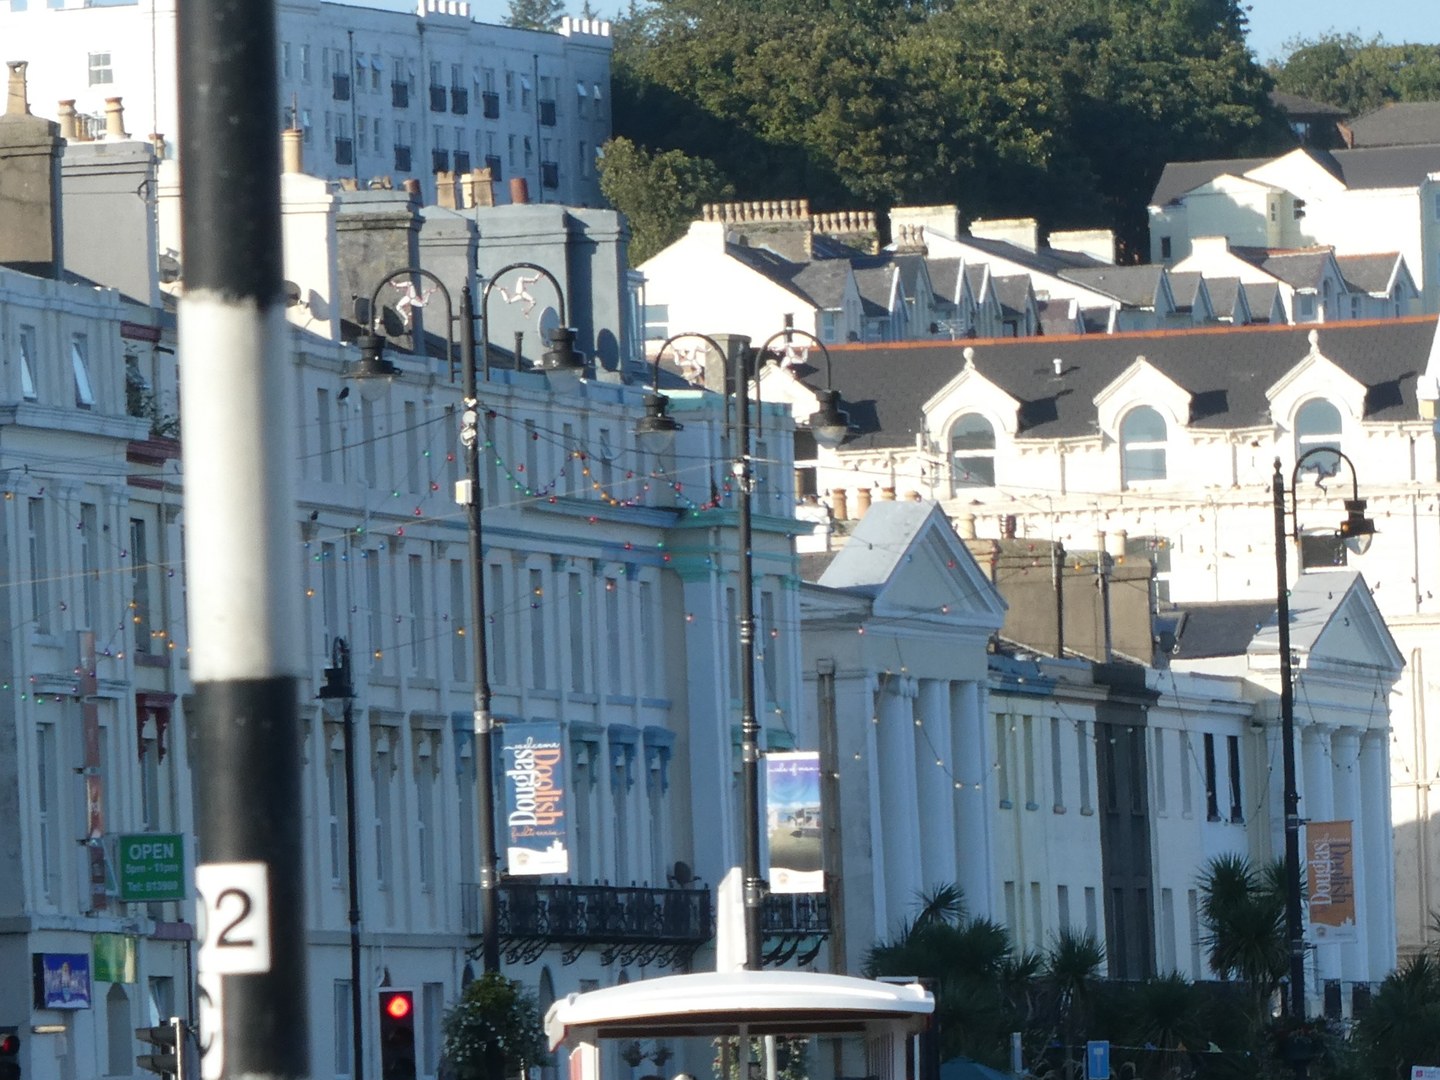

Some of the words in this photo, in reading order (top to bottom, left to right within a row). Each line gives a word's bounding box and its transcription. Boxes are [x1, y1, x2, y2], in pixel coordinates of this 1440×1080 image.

[507, 749, 541, 826] Douglas
[535, 749, 563, 826] Doolish
[129, 843, 175, 860] OPEN
[1308, 843, 1336, 905] Douglas
